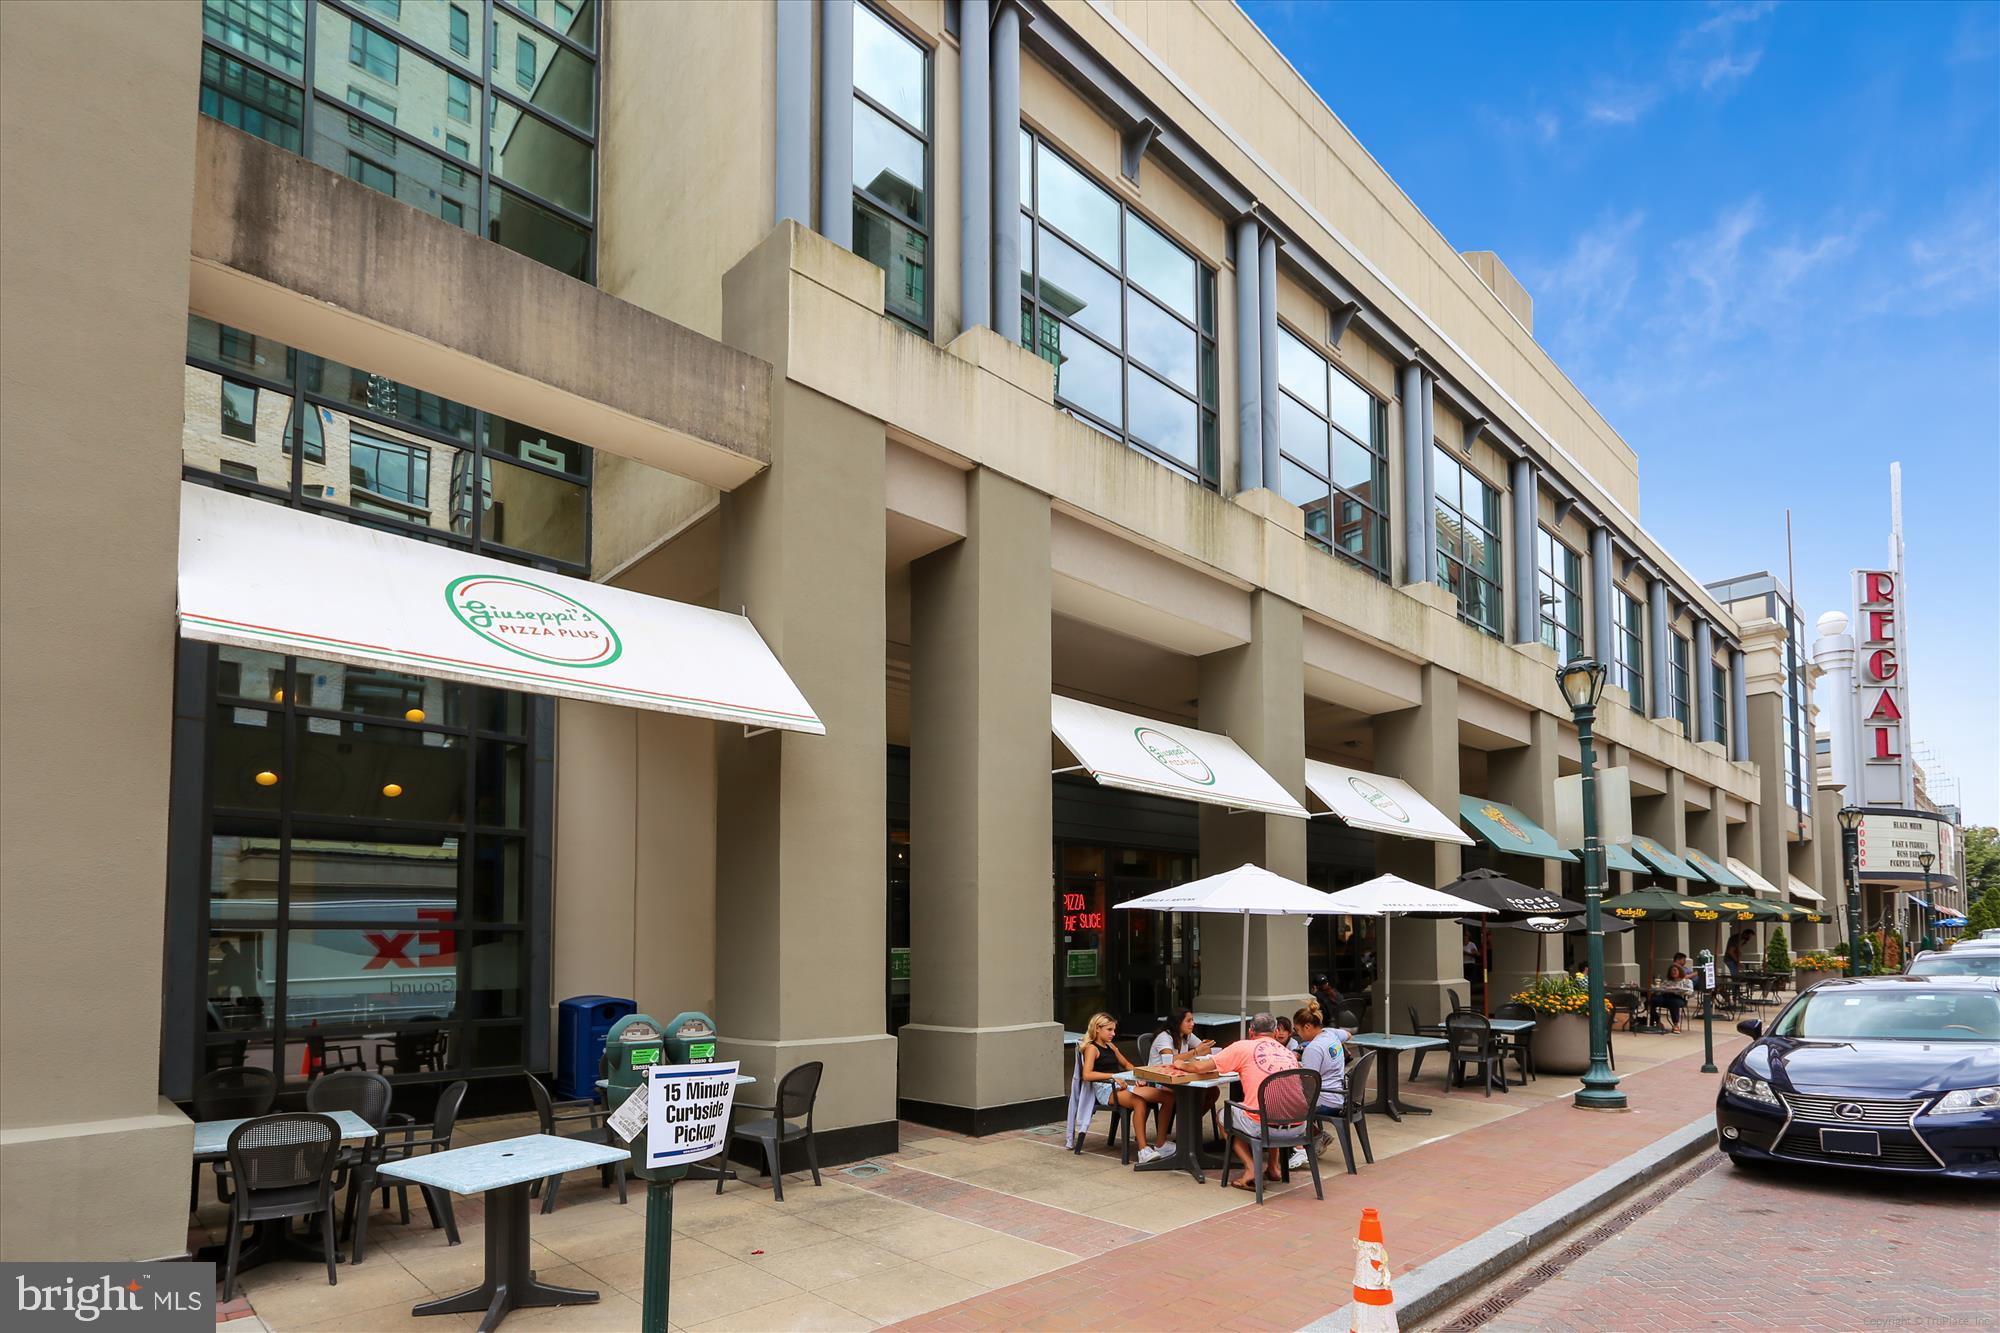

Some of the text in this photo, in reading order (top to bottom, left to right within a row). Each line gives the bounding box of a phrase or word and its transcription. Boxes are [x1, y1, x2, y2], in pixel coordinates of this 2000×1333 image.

[459, 600, 592, 628] Giuseppi's
[499, 624, 599, 639] PIZZA PLUS
[1864, 572, 1902, 759] REGAL
[1064, 893, 1085, 910] PIZZA
[1506, 896, 1553, 904] GOOSE
[1512, 902, 1560, 910] ISLAND
[1064, 913, 1101, 931] HE SLICE
[664, 1081, 730, 1102] 15 Minute
[666, 1101, 724, 1124] Curbside
[674, 1124, 716, 1144] Pickup
